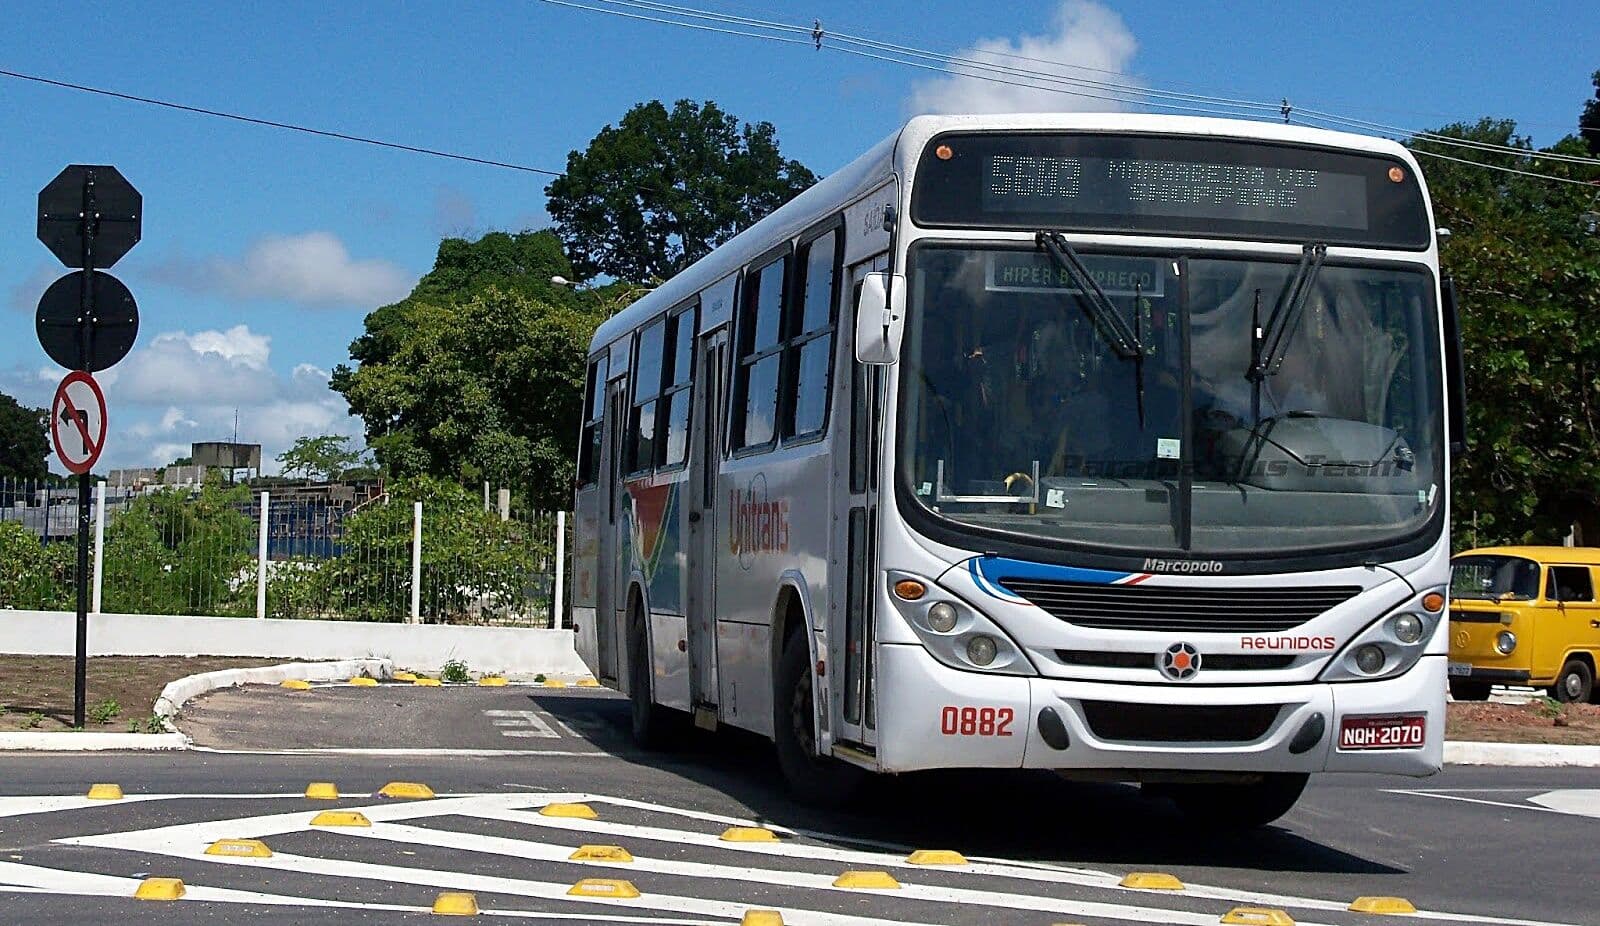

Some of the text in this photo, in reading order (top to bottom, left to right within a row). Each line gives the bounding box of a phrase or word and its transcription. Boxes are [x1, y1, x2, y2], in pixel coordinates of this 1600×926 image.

[991, 155, 1318, 198] 5603 MANGABEIRA VII
[1129, 183, 1297, 208] SHOPPING
[1003, 265, 1050, 284] HIPER
[730, 488, 789, 555] Unitrans
[1143, 557, 1223, 573] Marcopolo
[941, 706, 1014, 737] 0882
